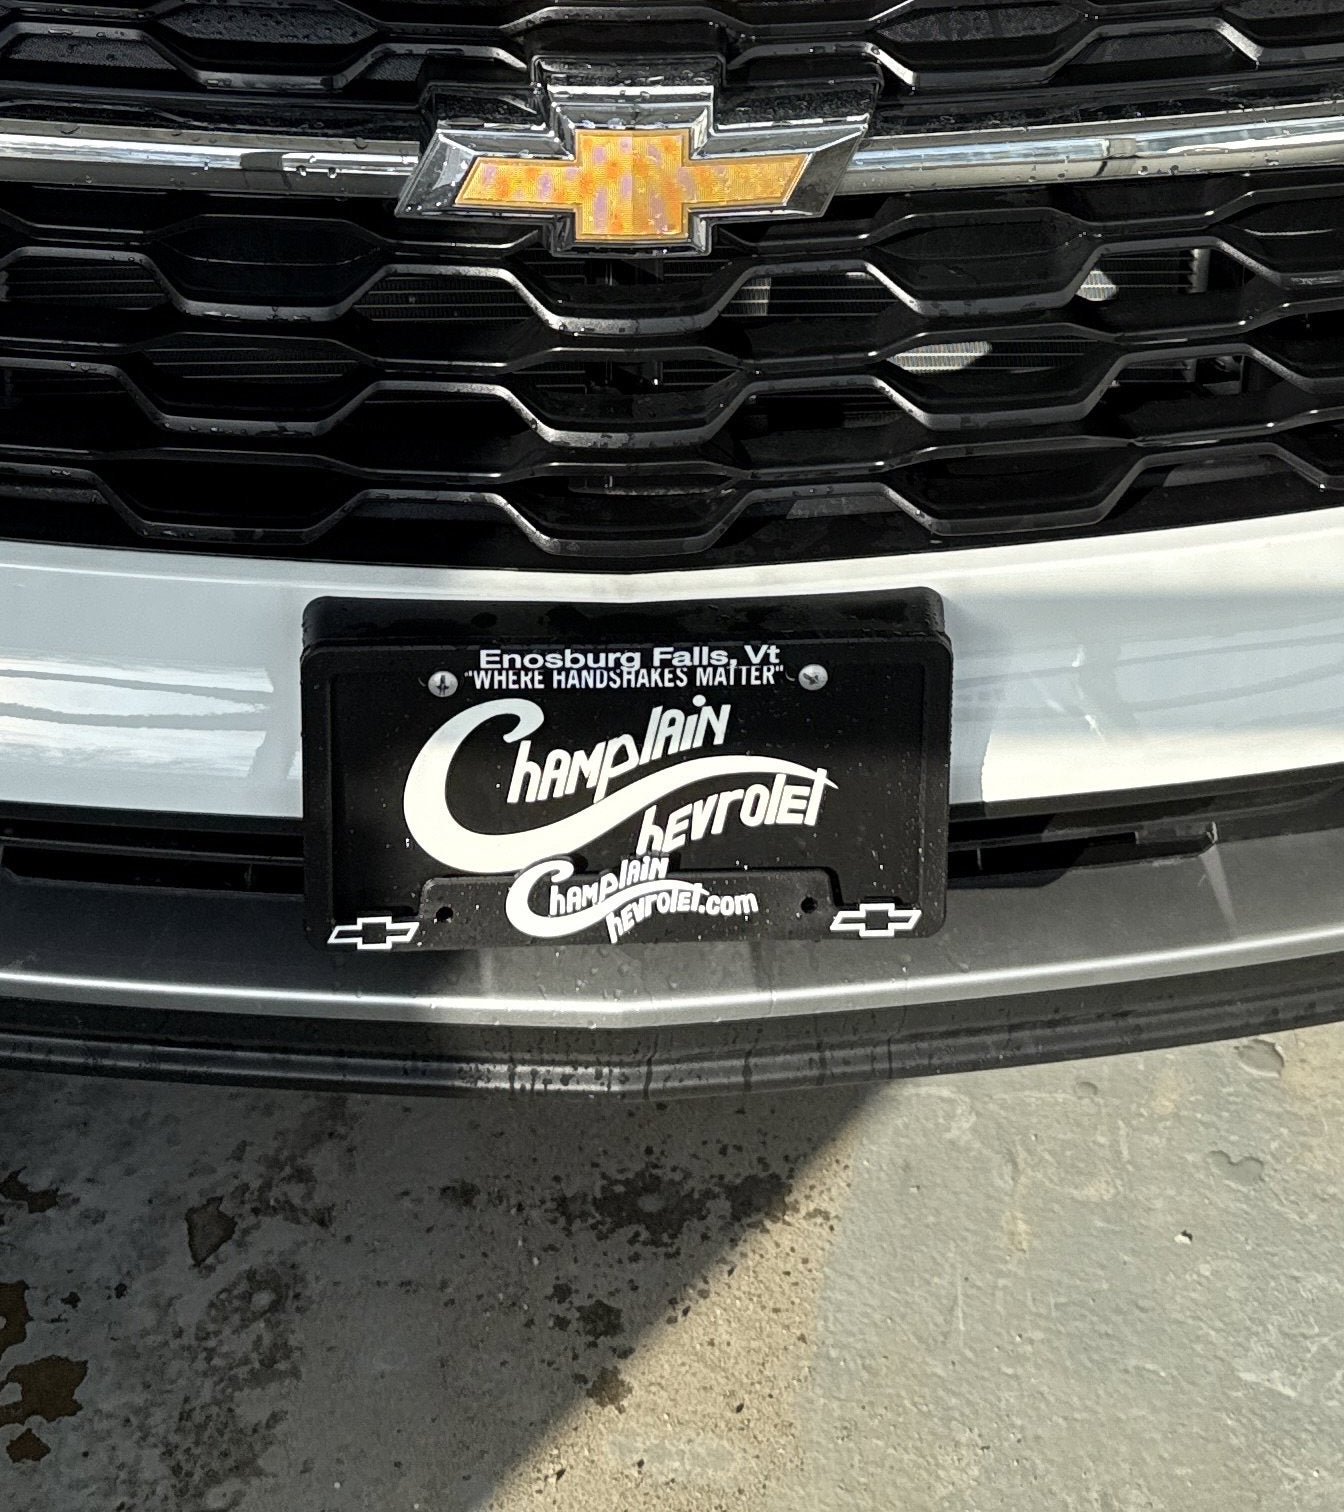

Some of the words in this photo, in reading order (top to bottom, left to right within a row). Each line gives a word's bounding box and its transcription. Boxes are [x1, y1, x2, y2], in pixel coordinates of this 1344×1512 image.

[479, 647, 643, 671] Enosburg
[653, 646, 737, 670] Falls,
[743, 644, 781, 666] Vt
[464, 668, 546, 690] "WHERE
[553, 668, 688, 689] HANDSHAKES
[695, 665, 784, 687] MATTER"
[403, 694, 734, 873] Champlain
